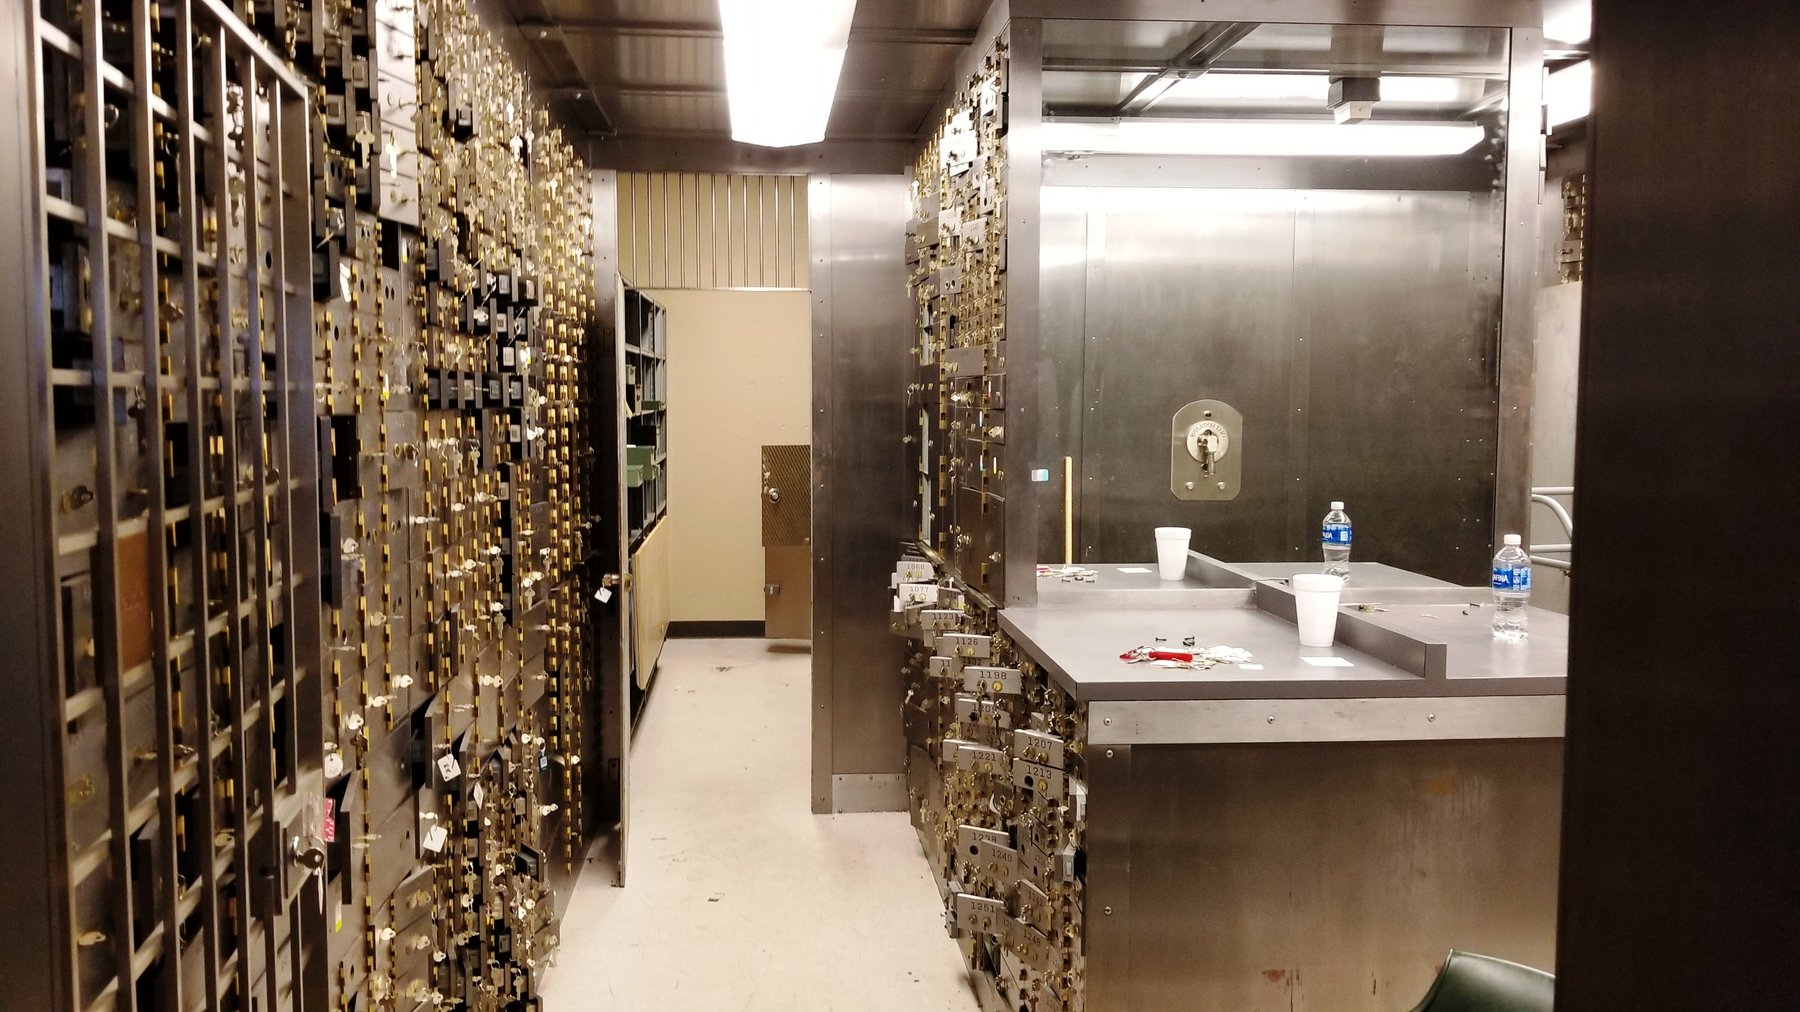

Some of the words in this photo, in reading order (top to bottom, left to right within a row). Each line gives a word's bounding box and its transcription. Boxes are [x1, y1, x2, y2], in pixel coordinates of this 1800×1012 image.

[956, 638, 979, 646] 1126
[980, 671, 1007, 680] 1198
[1028, 737, 1053, 750] 1207
[972, 751, 997, 762] 1221
[1027, 765, 1052, 779] 1213
[992, 848, 1013, 863] 1240
[970, 901, 996, 913] 1251
